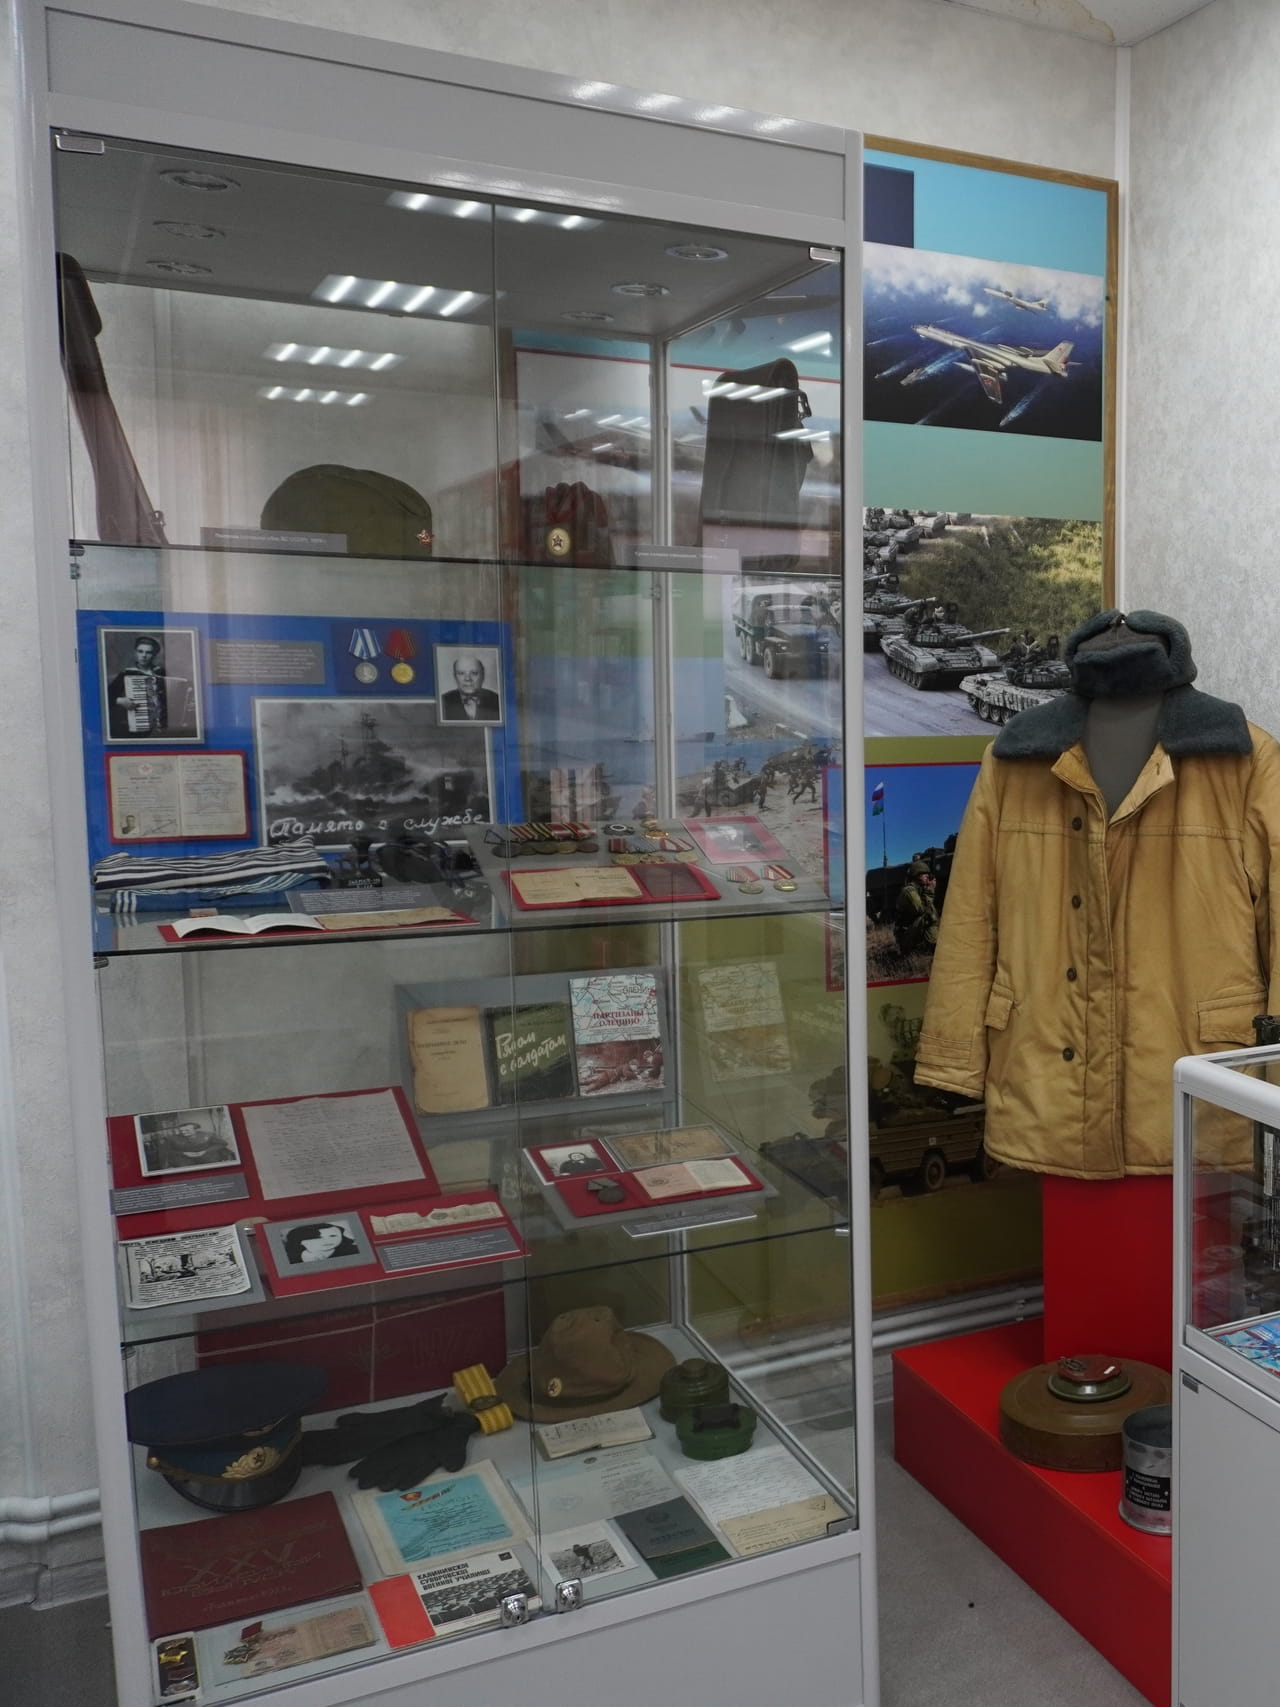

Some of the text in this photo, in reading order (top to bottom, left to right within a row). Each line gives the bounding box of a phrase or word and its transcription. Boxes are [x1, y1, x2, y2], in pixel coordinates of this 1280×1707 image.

[269, 816, 363, 838] Память
[403, 808, 486, 836] службе
[495, 1031, 536, 1060] Рядом
[500, 1034, 567, 1076] с солдатом
[417, 1562, 469, 1580] КАЛИНИНСКОЕ
[420, 1568, 468, 1585] СУВОРОВСКОЕ
[422, 1568, 490, 1590] ВОЕННОЕ УЧИЛИЩЕ
